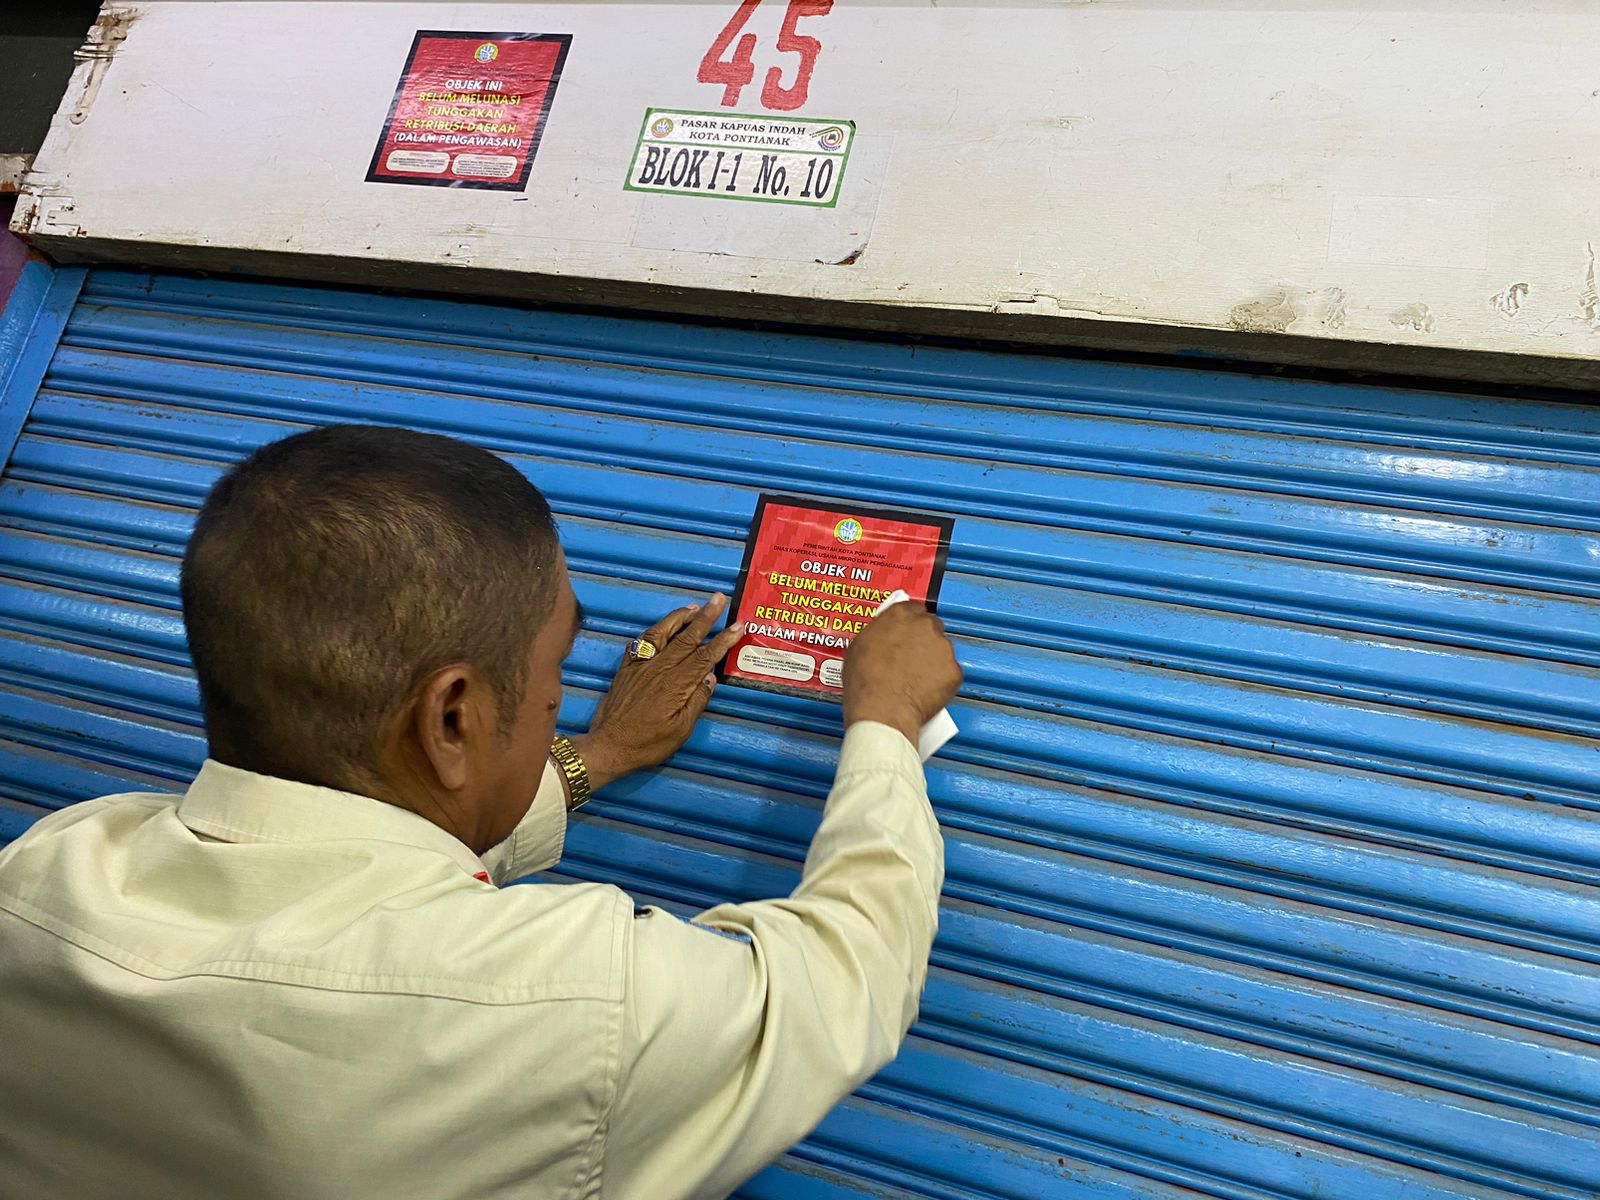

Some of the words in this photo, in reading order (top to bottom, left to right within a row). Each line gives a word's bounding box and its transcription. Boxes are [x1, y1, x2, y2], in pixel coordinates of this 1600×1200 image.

[697, 0, 835, 111] 45
[445, 79, 482, 90] OBJEK
[485, 81, 503, 90] INI
[418, 91, 457, 103] BELUM
[459, 94, 521, 106] MELUNASI
[426, 106, 503, 119] TUNGGAKAN
[405, 120, 465, 131] RETRIBUSI
[467, 122, 517, 134] DAERAH
[680, 119, 718, 129] PASAR
[720, 121, 766, 133] KAPUAS
[768, 124, 807, 136] INDAH
[393, 132, 436, 144] (DALAM
[438, 134, 523, 149] PENGAWASAN)
[689, 131, 721, 141] KOTA
[723, 134, 791, 146] PONTIANAK
[638, 145, 709, 188] BLOK
[753, 154, 790, 197] No.
[800, 158, 834, 199] 10
[802, 542, 838, 553] PEMERINTAH
[838, 547, 854, 555] KOTA
[837, 555, 857, 563] MIKRO
[800, 560, 848, 578] OBJEK
[850, 566, 873, 582] INI
[768, 571, 817, 593] BELUM
[819, 580, 892, 603] MELUNAS
[781, 592, 877, 618] TUNGGAKAN
[754, 606, 830, 629] RETRIBUSI
[743, 621, 797, 641] (DALAM
